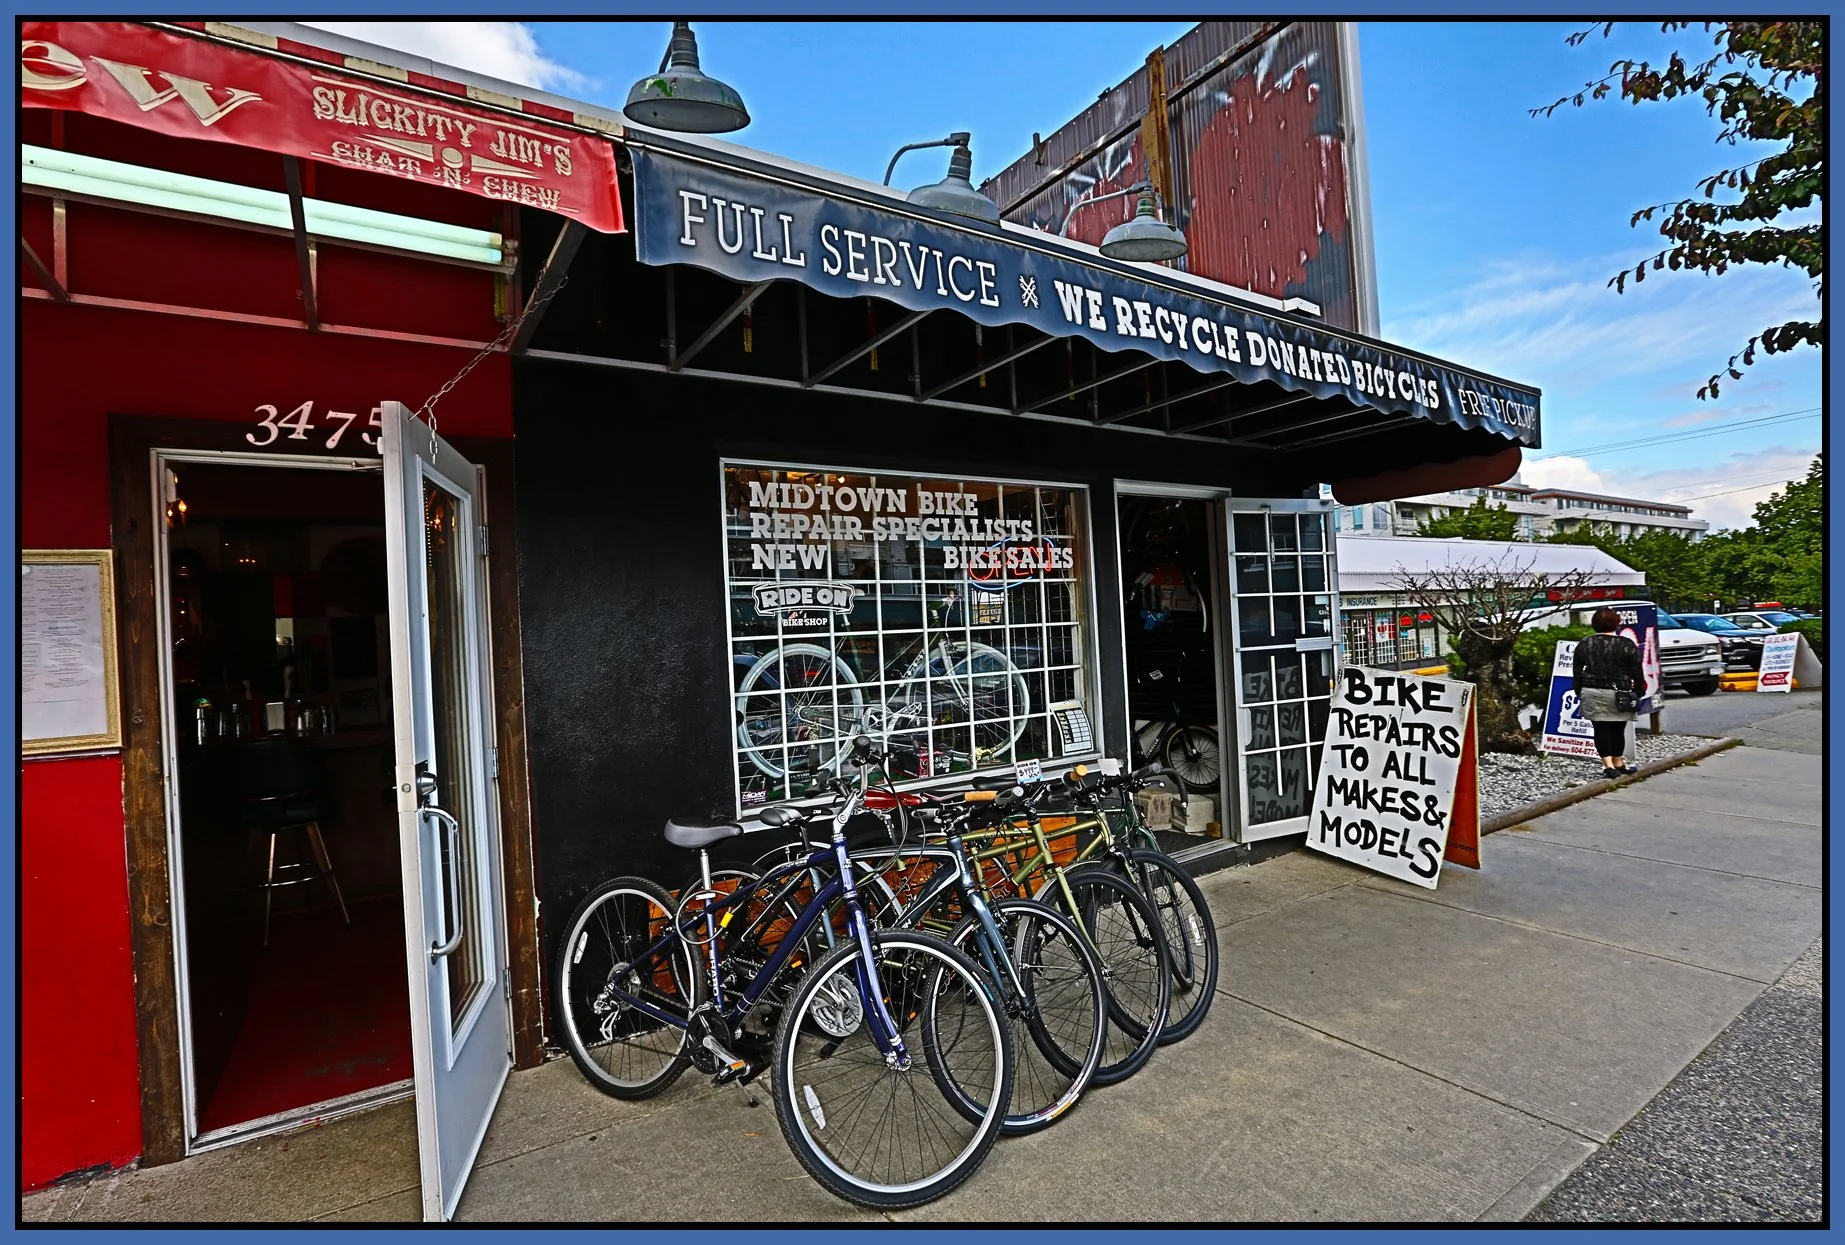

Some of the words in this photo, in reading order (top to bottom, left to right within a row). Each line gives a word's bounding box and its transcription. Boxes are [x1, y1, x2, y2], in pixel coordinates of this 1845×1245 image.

[312, 86, 476, 148] SLICKITY
[331, 141, 421, 179] CHAT
[483, 176, 561, 209] CHEW
[679, 190, 805, 267] FULL
[821, 224, 1000, 308] SERVICE
[1054, 280, 1107, 332] WE
[1112, 295, 1242, 364] RECYCLE
[1246, 331, 1351, 386] DONATED
[1351, 360, 1440, 410] BICYCLES
[246, 400, 382, 449] 3475
[749, 481, 907, 513] MIDTOWN
[918, 491, 979, 516] BIKE
[750, 512, 863, 540] REPAIR
[873, 517, 1033, 542] SPECIALISTS
[751, 544, 828, 570] NEW
[943, 546, 1001, 569] BIKE
[1006, 547, 1074, 569] SALES
[761, 587, 814, 608] RIDE
[816, 588, 848, 607] ON
[1346, 597, 1378, 607] INSURANCE
[782, 618, 804, 627] BIKE
[804, 617, 828, 627] SHOP
[1343, 668, 1453, 715] BIKE
[1331, 707, 1460, 758] REPAIRS
[1558, 738, 1584, 747] Sanitize
[1331, 744, 1369, 771] TO
[1381, 750, 1436, 785] ALL
[1320, 810, 1441, 878] MODELS
